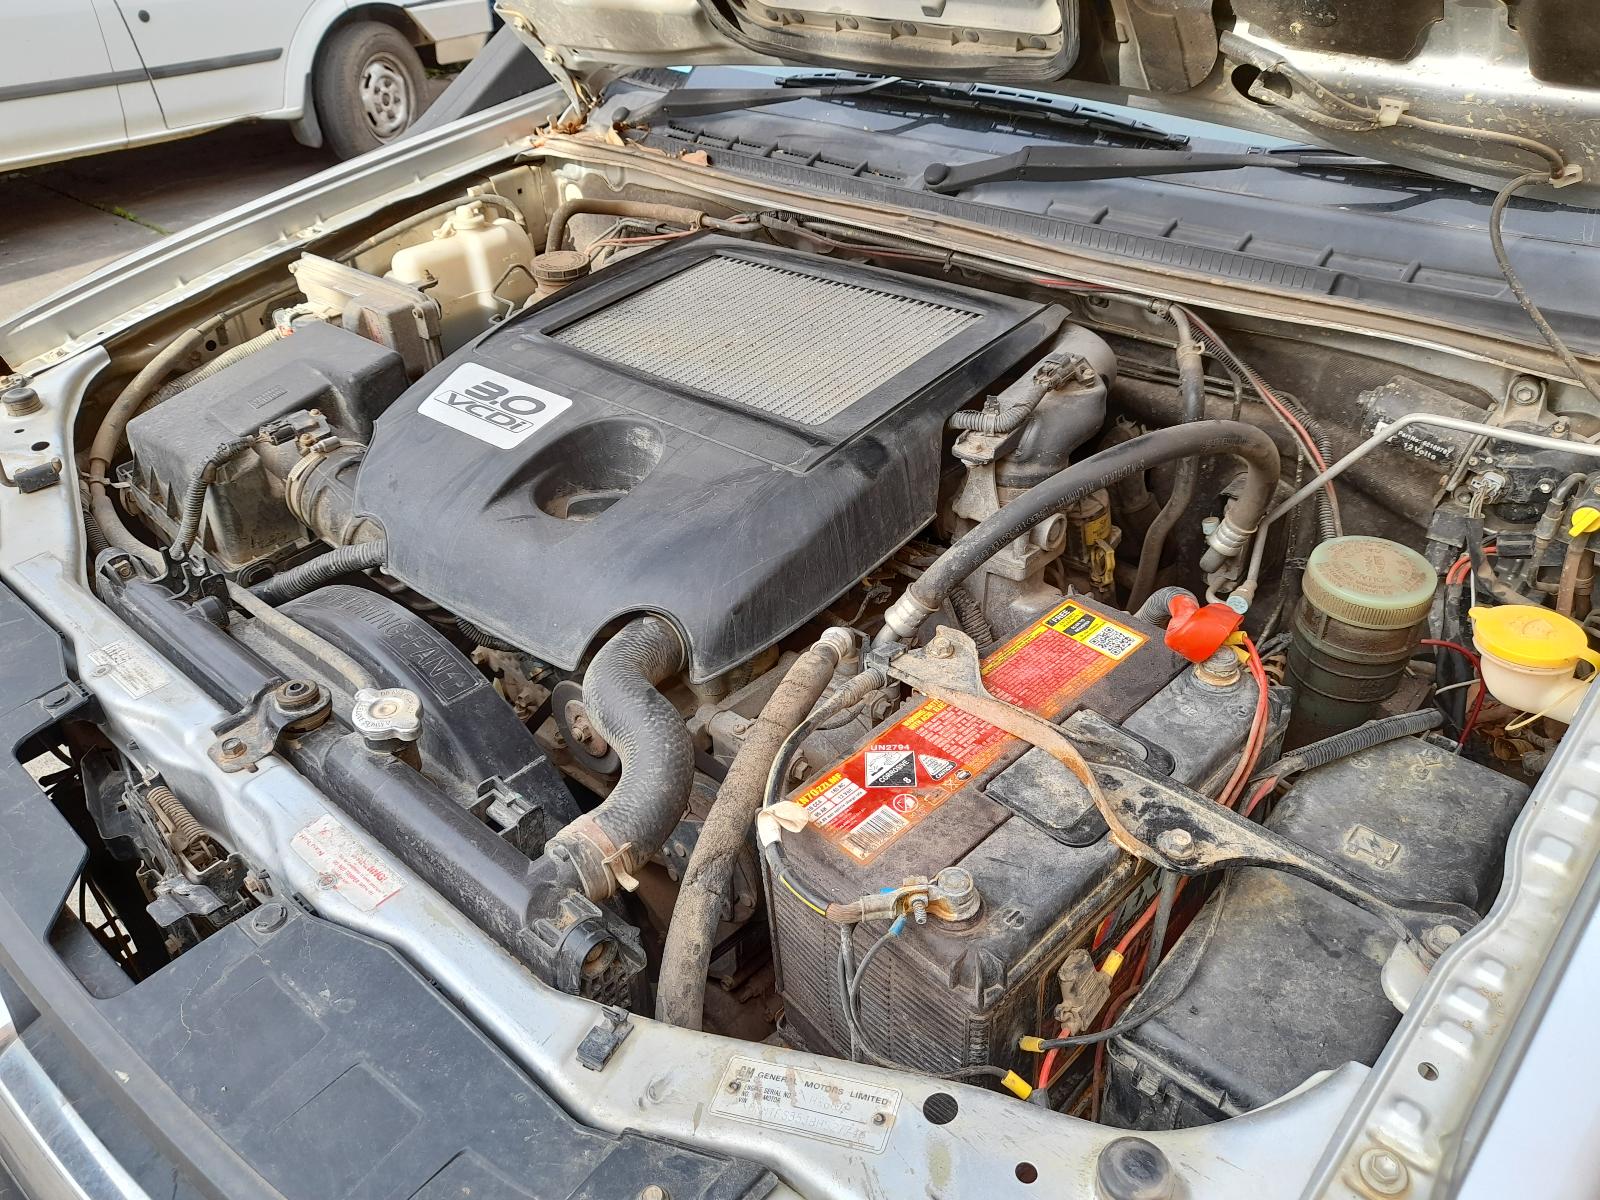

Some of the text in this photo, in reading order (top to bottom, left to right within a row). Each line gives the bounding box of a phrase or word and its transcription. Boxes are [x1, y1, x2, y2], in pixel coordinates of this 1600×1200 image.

[464, 380, 546, 416] 3.0
[448, 393, 527, 430] VCDi
[1051, 608, 1071, 622] FREE
[878, 758, 910, 784] CORROSIVE
[804, 1080, 844, 1095] MOTORS
[850, 1090, 888, 1106] LIMITED
